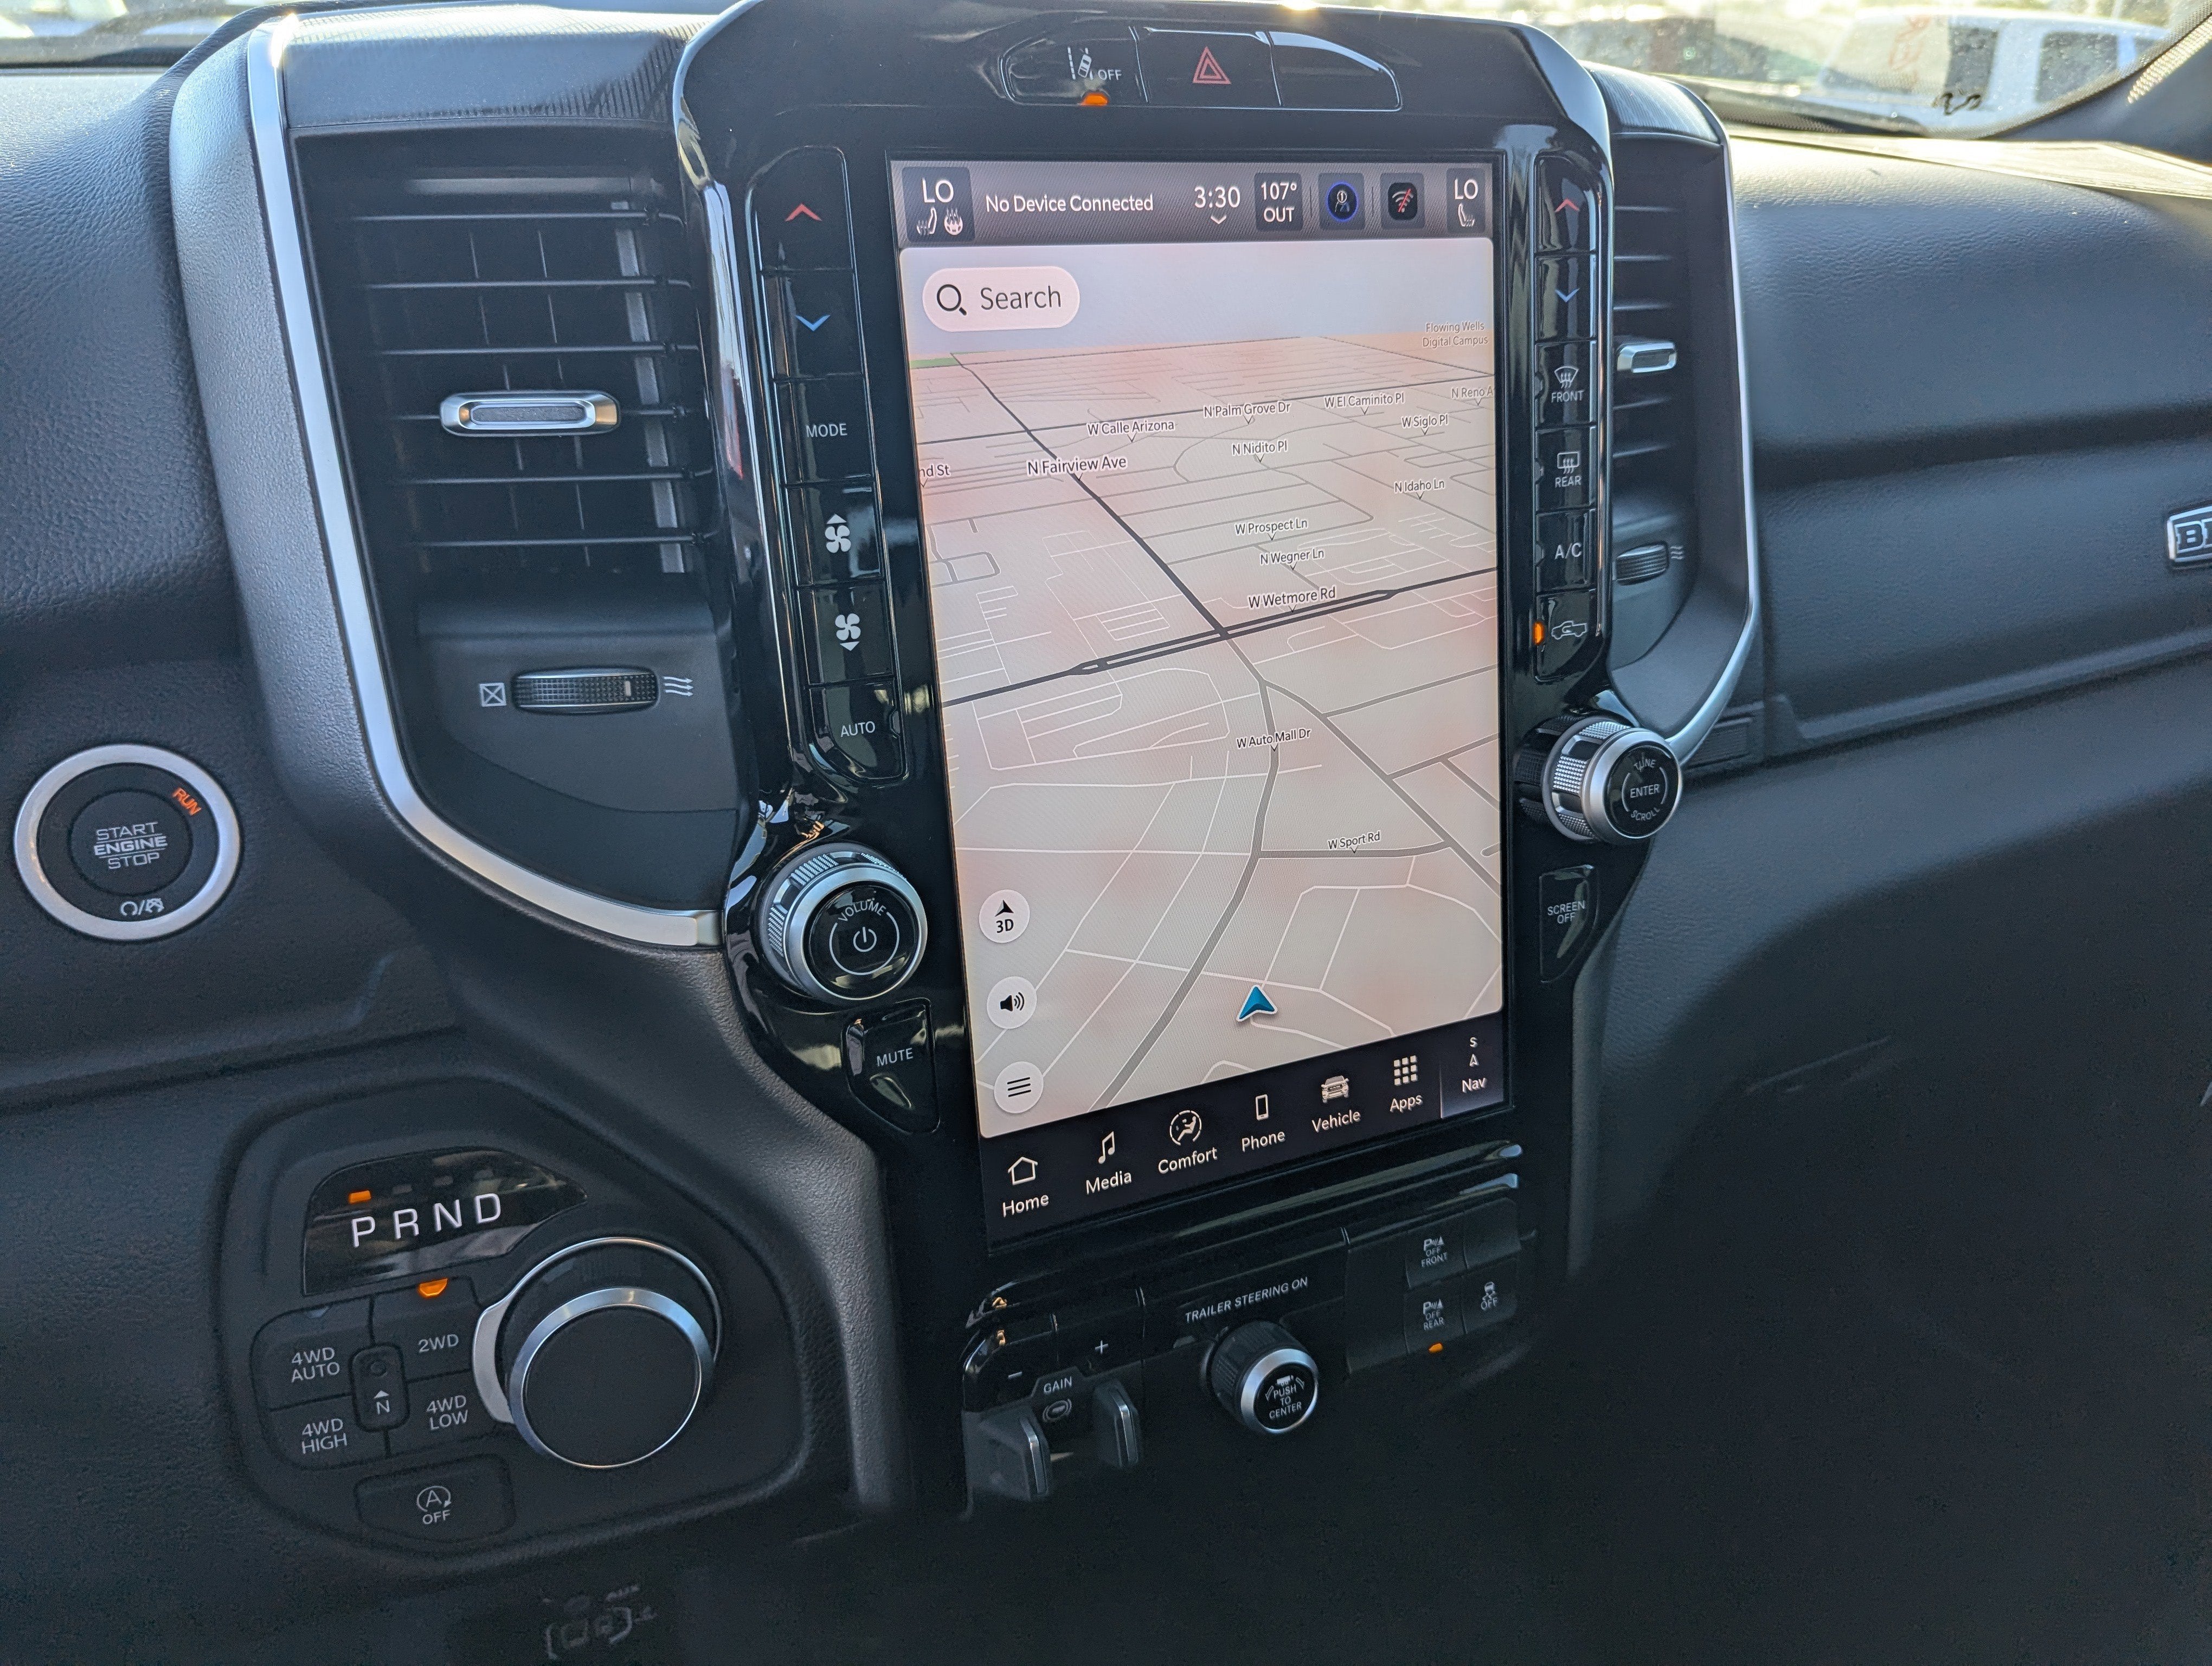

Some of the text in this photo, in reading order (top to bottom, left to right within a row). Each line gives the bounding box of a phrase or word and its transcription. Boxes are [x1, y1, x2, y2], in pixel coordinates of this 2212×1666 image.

[1098, 69, 1122, 80] OFF
[922, 178, 954, 203] LO
[1194, 185, 1240, 209] 3:30
[1454, 179, 1478, 200] LO
[986, 193, 1154, 213] No Device Connected
[1263, 206, 1295, 223] OUT
[980, 285, 1062, 311] Search
[1425, 321, 1485, 334] Flowing Wells
[1423, 335, 1488, 348] Digital Campus
[1324, 393, 1404, 408] W El Caminito Pl
[1452, 386, 1494, 399] N Reno A
[1551, 390, 1585, 403] FRONT
[1204, 402, 1291, 417] N Palm Grove Dr
[806, 423, 848, 438] MODE
[1087, 420, 1175, 435] W Calle Arizona
[1402, 415, 1448, 429] W Siglo Pl
[1232, 440, 1287, 455] N Nidito Pl
[937, 464, 949, 476] St
[1027, 456, 1127, 476] N Fairview Ave
[1395, 479, 1444, 493] N Idaho Ln
[1554, 476, 1582, 488] REAR
[1235, 518, 1307, 534] W Prospect Ln
[1261, 548, 1324, 564] N Wegner Ln
[1555, 542, 1582, 560] A/C
[1249, 587, 1336, 608] W Wetmore Rd
[840, 720, 876, 738] AUTO
[1237, 728, 1311, 748] W Auto Mall Dr
[1634, 758, 1656, 772] TUNE
[1630, 784, 1660, 798] ENTER
[172, 787, 201, 816] RUN
[1631, 807, 1660, 821] SCROLL
[96, 822, 158, 840] START
[93, 836, 168, 855] ENGINE
[1328, 831, 1380, 849] W Sport Rd
[108, 851, 160, 869] STOP
[838, 901, 886, 923] VOLUME
[1547, 900, 1586, 917] SCREEN
[996, 918, 1014, 933] 3D
[1557, 911, 1575, 924] OFF
[1470, 1036, 1478, 1048] S
[876, 1047, 914, 1067] MUTE
[1462, 1077, 1487, 1093] Nav
[1390, 1093, 1423, 1113] Apps
[1311, 1109, 1361, 1133] Vehicle
[1241, 1130, 1285, 1152] Phone
[1158, 1146, 1218, 1174] Comfort
[1086, 1170, 1132, 1195] Media
[1002, 1194, 1049, 1218] Home
[351, 1193, 501, 1247] P R N D
[1422, 1252, 1448, 1267] FRONT
[1426, 1247, 1441, 1257] OFF
[1186, 1277, 1308, 1323] TRAILER STEERING ON
[1481, 1297, 1498, 1311] OFF
[1423, 1317, 1444, 1330] REAR
[1426, 1310, 1440, 1321] OFF
[418, 1333, 460, 1352] 2WD
[291, 1347, 335, 1364] 4WD
[291, 1361, 340, 1383] AUTO
[1043, 1376, 1072, 1395] GAIN
[1274, 1383, 1296, 1399] PUSH
[376, 1400, 390, 1414] N
[426, 1394, 467, 1414] 4WD
[1281, 1396, 1291, 1406] TO
[1269, 1401, 1301, 1420] CENTER
[302, 1418, 343, 1437] 4WD
[429, 1409, 468, 1431] LOW
[301, 1433, 348, 1454] HIGH
[422, 1510, 451, 1525] OFF
